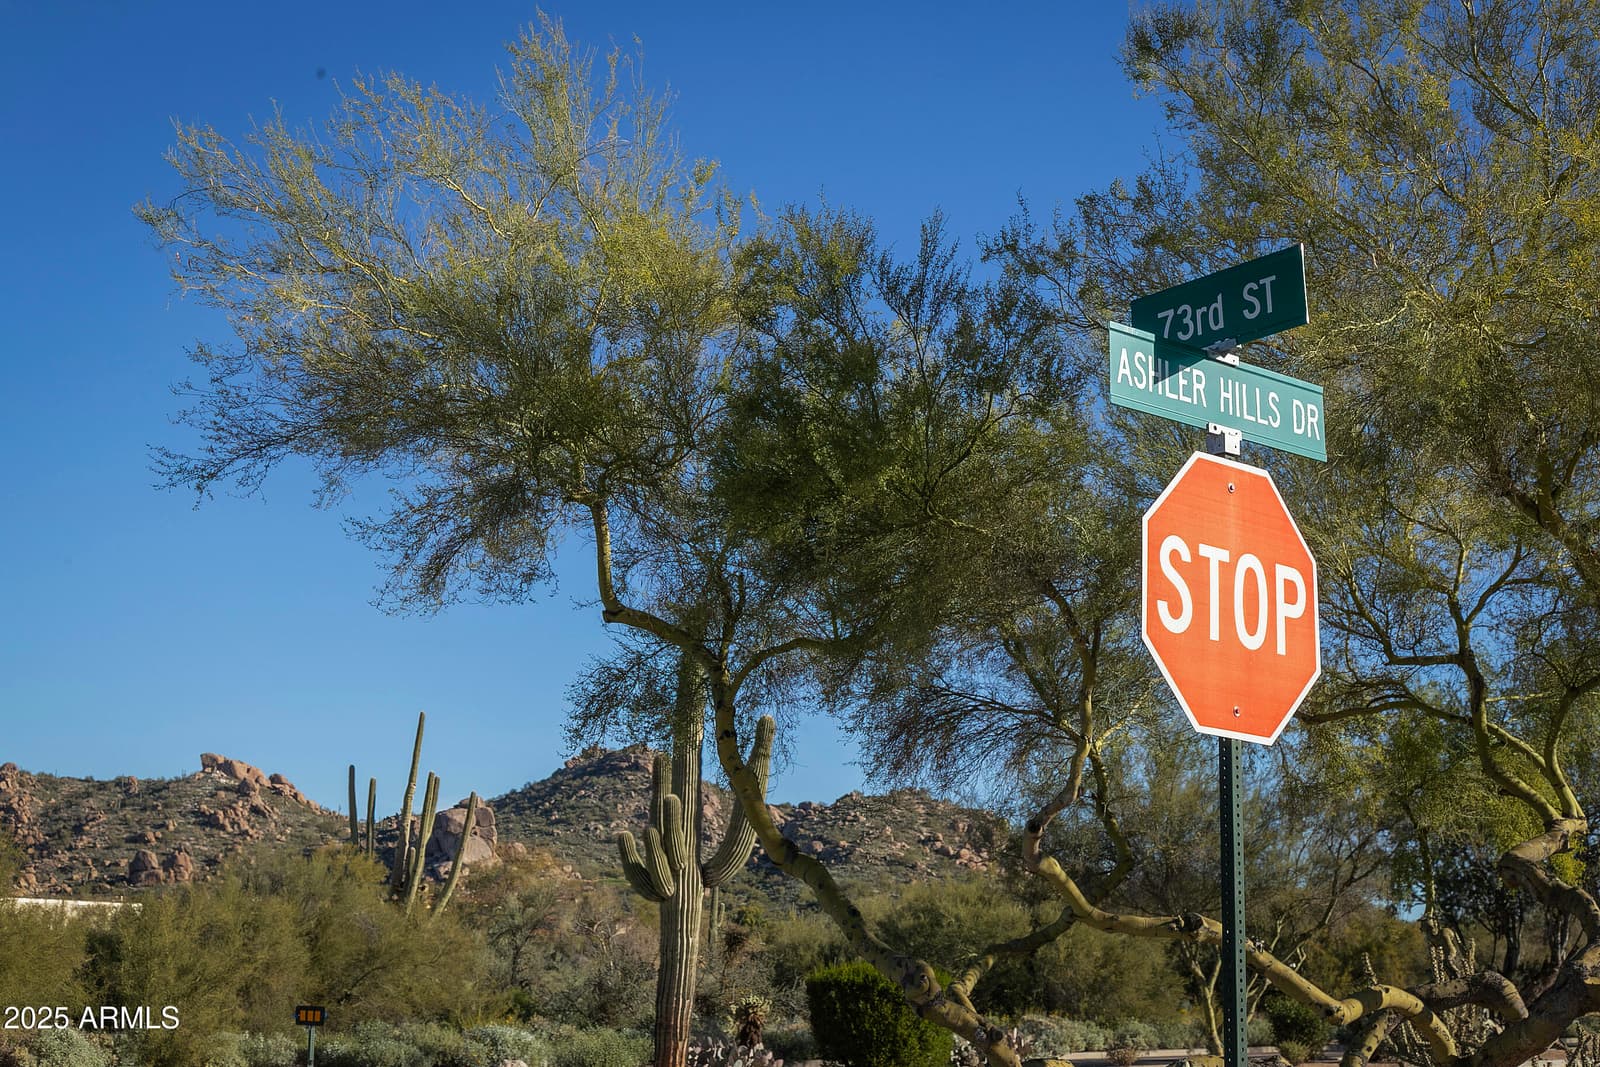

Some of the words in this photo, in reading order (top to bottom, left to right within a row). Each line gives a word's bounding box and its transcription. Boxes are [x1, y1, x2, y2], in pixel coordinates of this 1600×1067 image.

[1157, 293, 1224, 341] 73rd
[1242, 275, 1276, 320] ST
[1117, 348, 1207, 408] ASHLER
[1219, 376, 1281, 428] HILLS
[1292, 399, 1321, 441] DR
[1156, 534, 1307, 656] STOP
